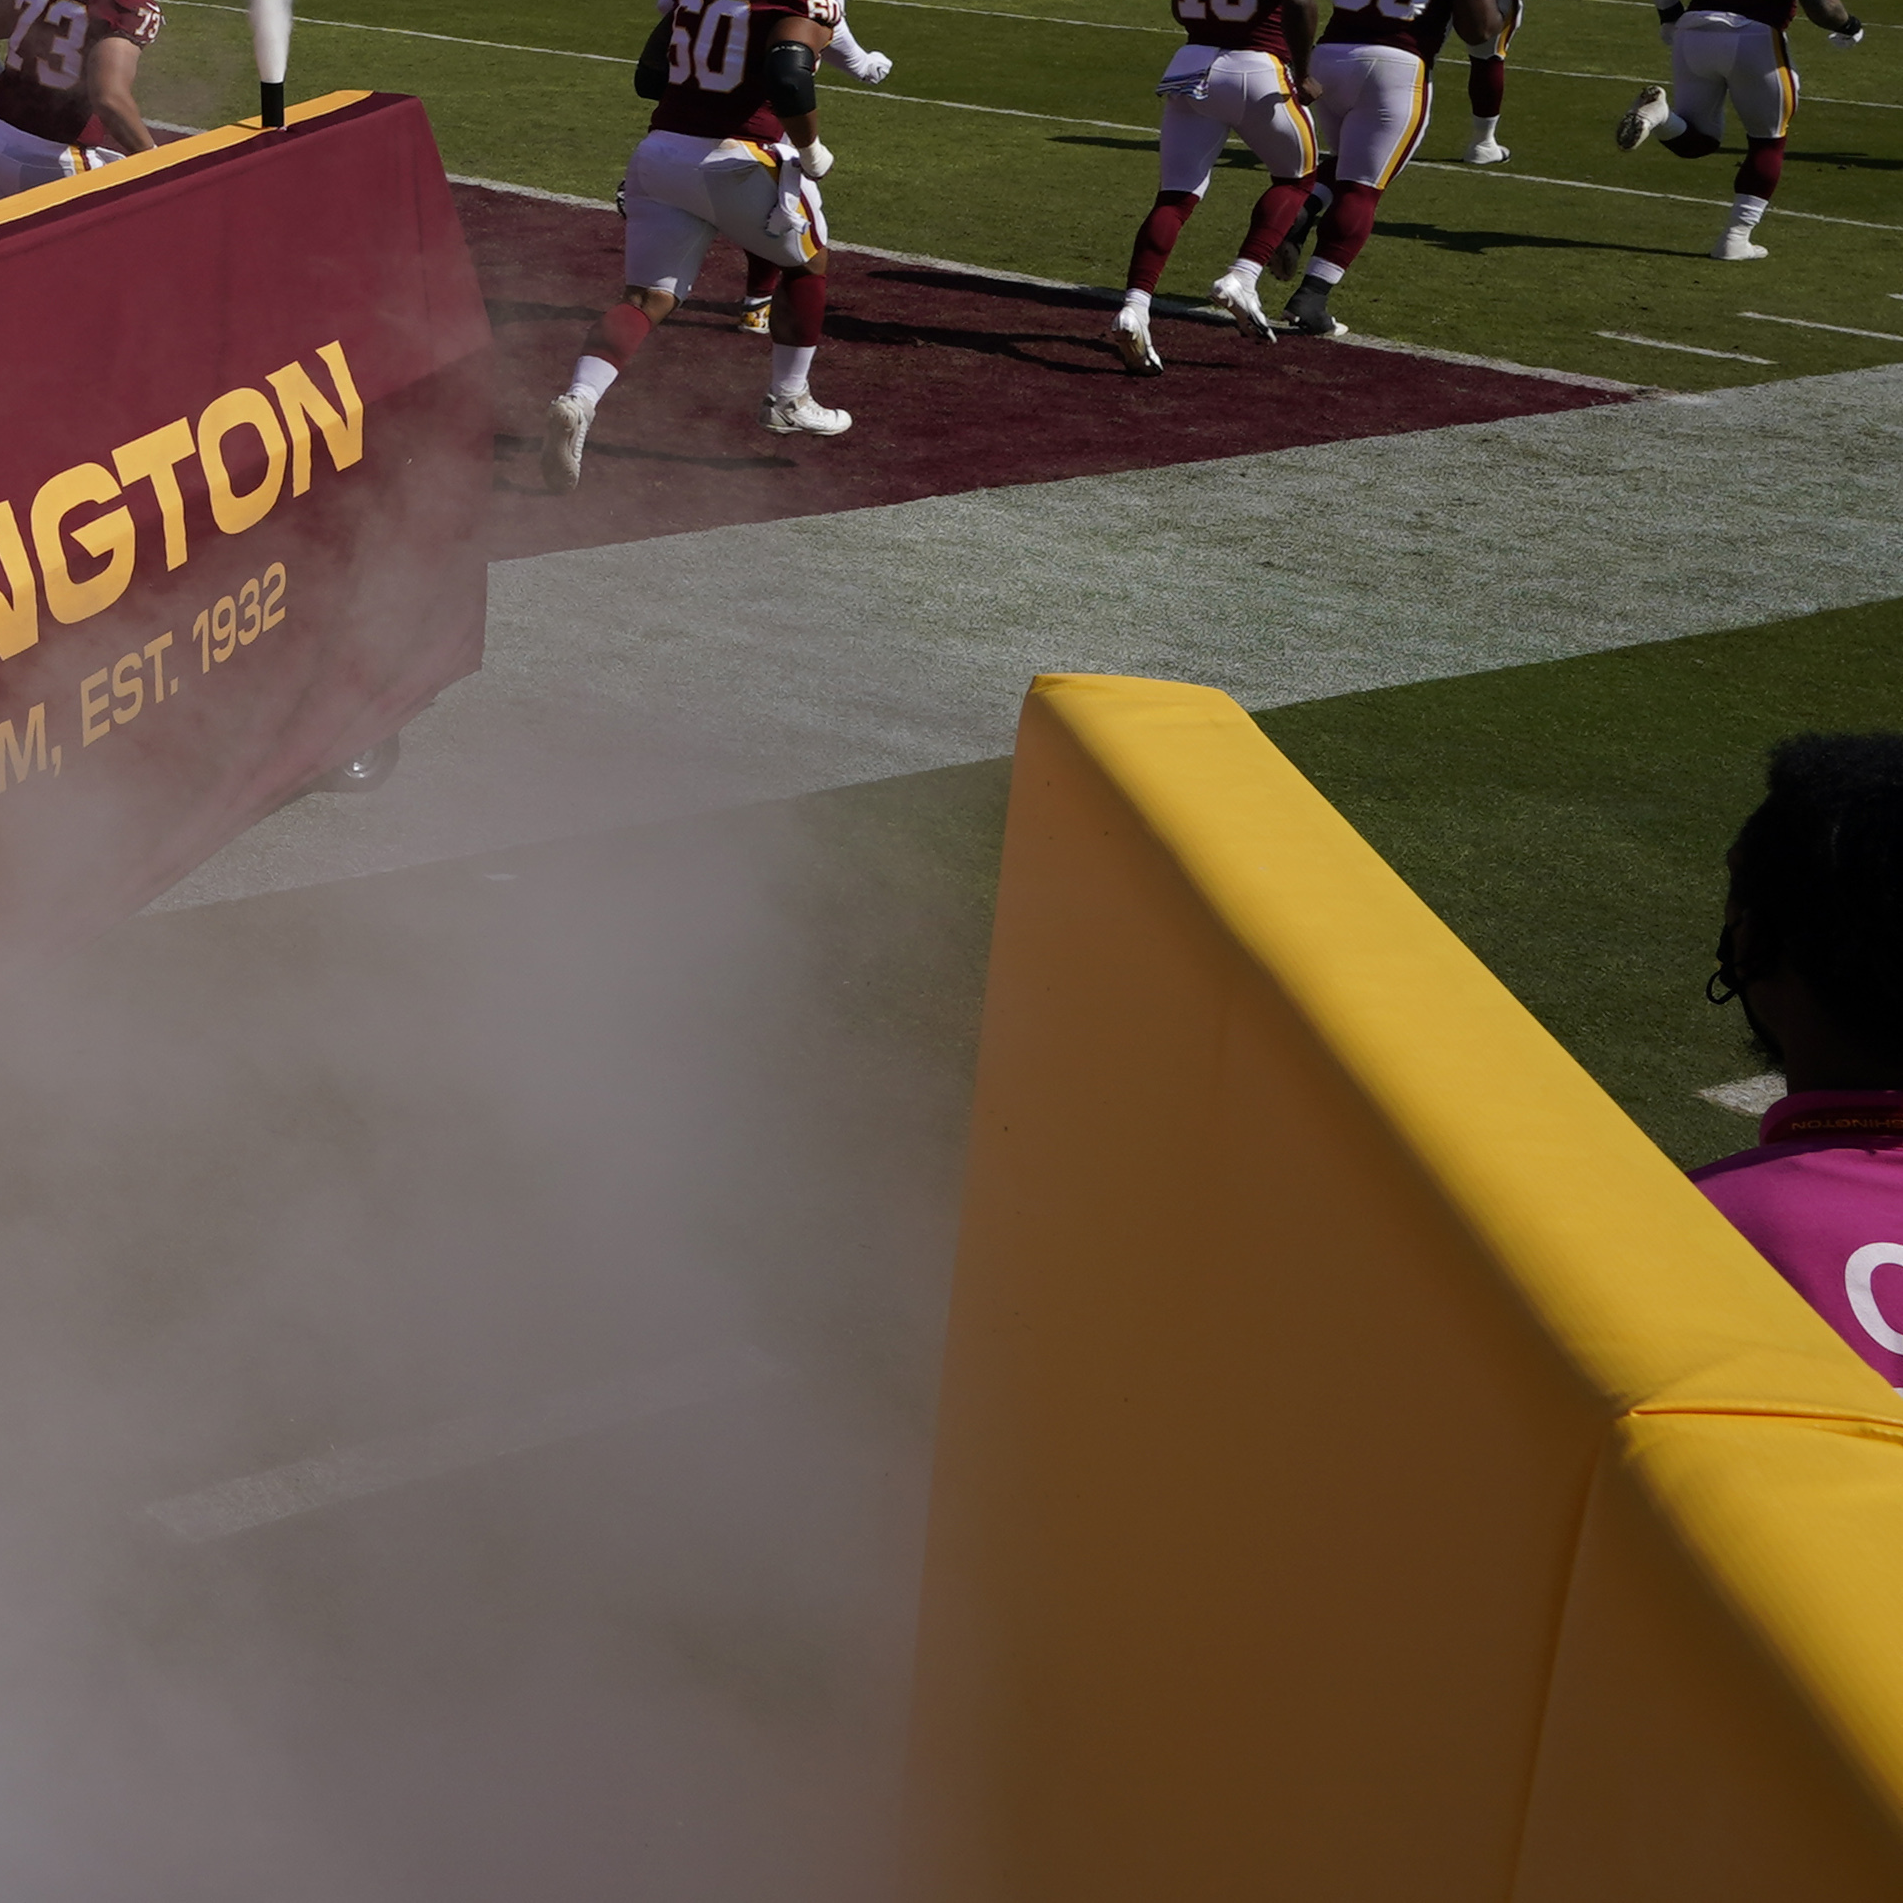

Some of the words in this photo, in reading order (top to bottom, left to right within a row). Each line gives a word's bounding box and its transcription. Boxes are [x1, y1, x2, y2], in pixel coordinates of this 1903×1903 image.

[134, 7, 163, 39] 73
[80, 627, 180, 749] EST.
[192, 561, 287, 677] 1932
